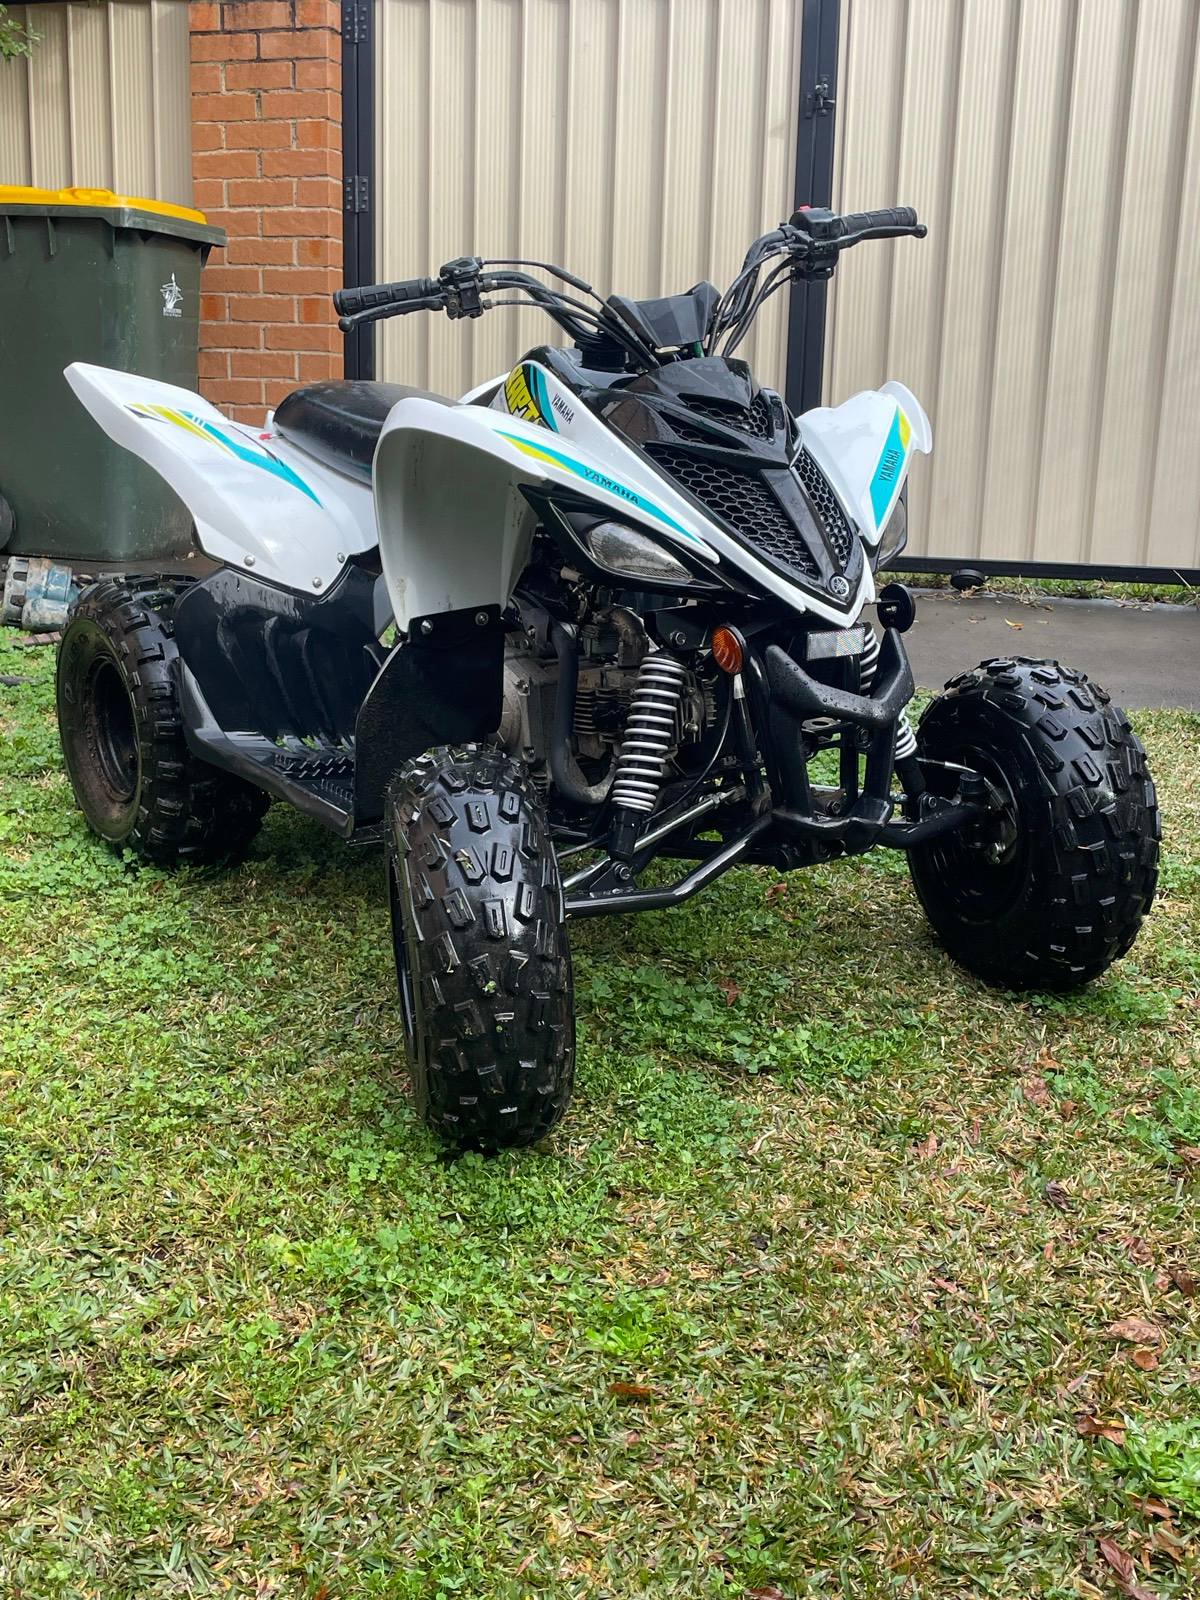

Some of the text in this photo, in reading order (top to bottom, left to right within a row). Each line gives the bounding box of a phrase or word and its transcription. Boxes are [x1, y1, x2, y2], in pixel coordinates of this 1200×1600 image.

[552, 393, 575, 425] YAMAHA
[879, 449, 900, 482] YAMAHA
[584, 468, 640, 505] YAMAHA
